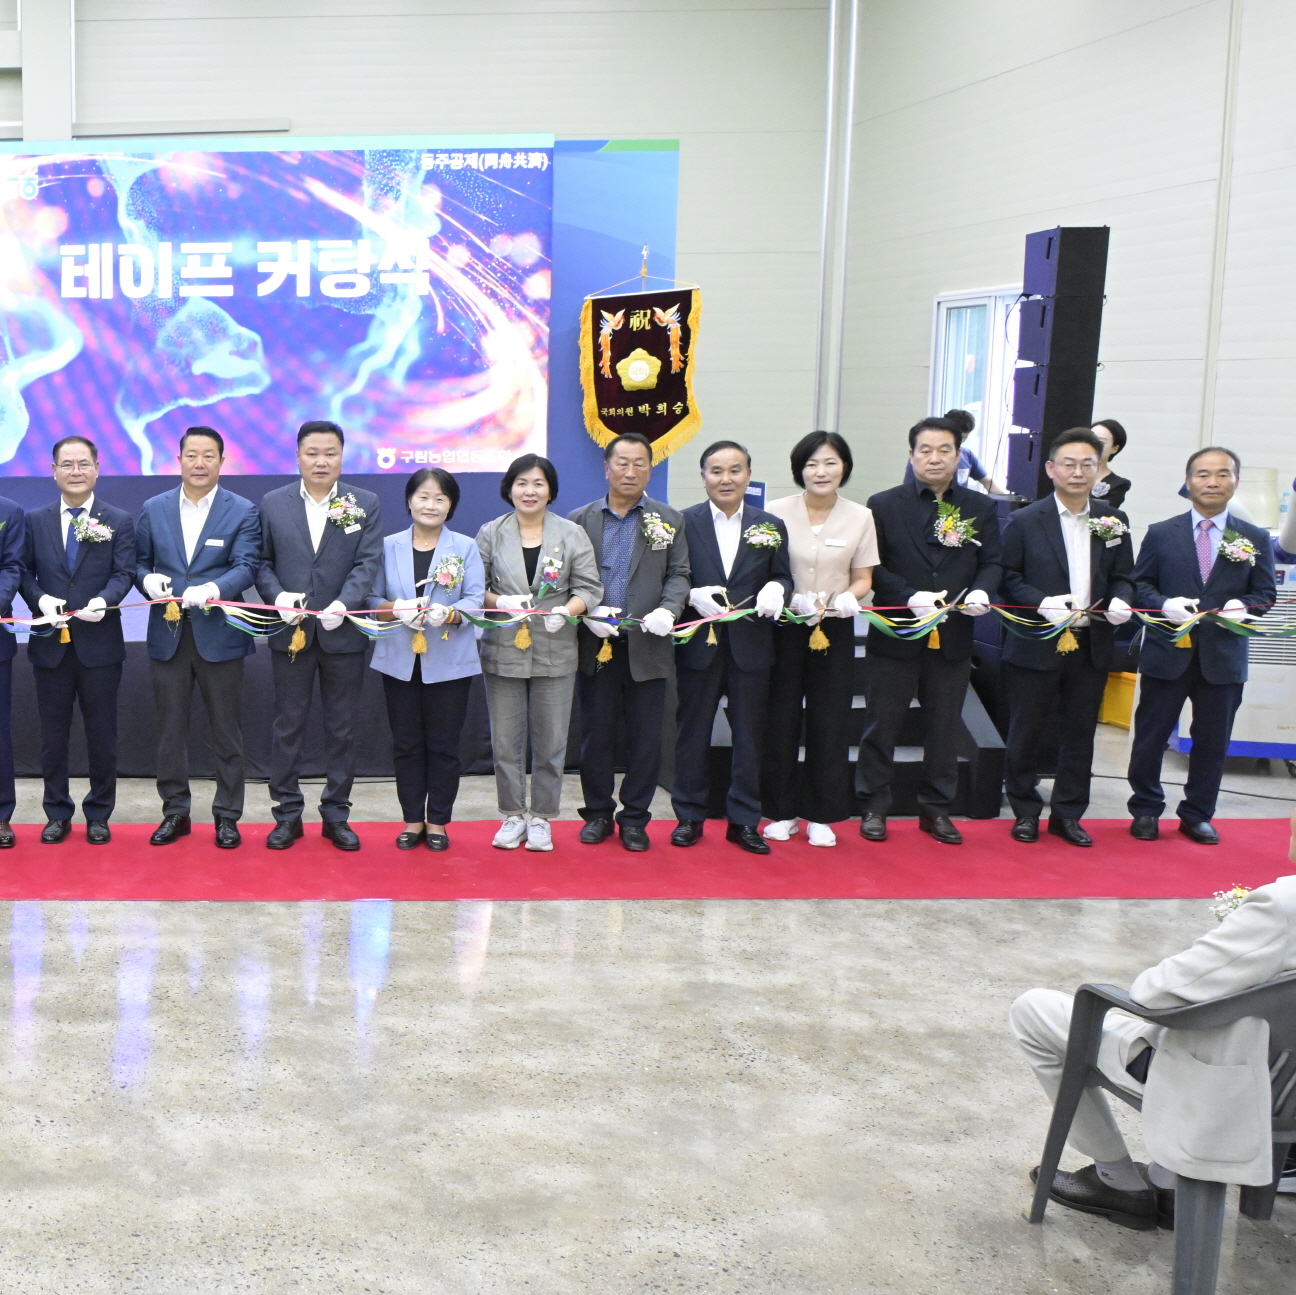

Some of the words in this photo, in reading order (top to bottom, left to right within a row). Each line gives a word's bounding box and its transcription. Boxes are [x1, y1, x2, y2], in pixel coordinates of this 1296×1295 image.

[59, 241, 234, 299] 테이프
[629, 309, 651, 331] 祝
[600, 406, 634, 417] 국회의원
